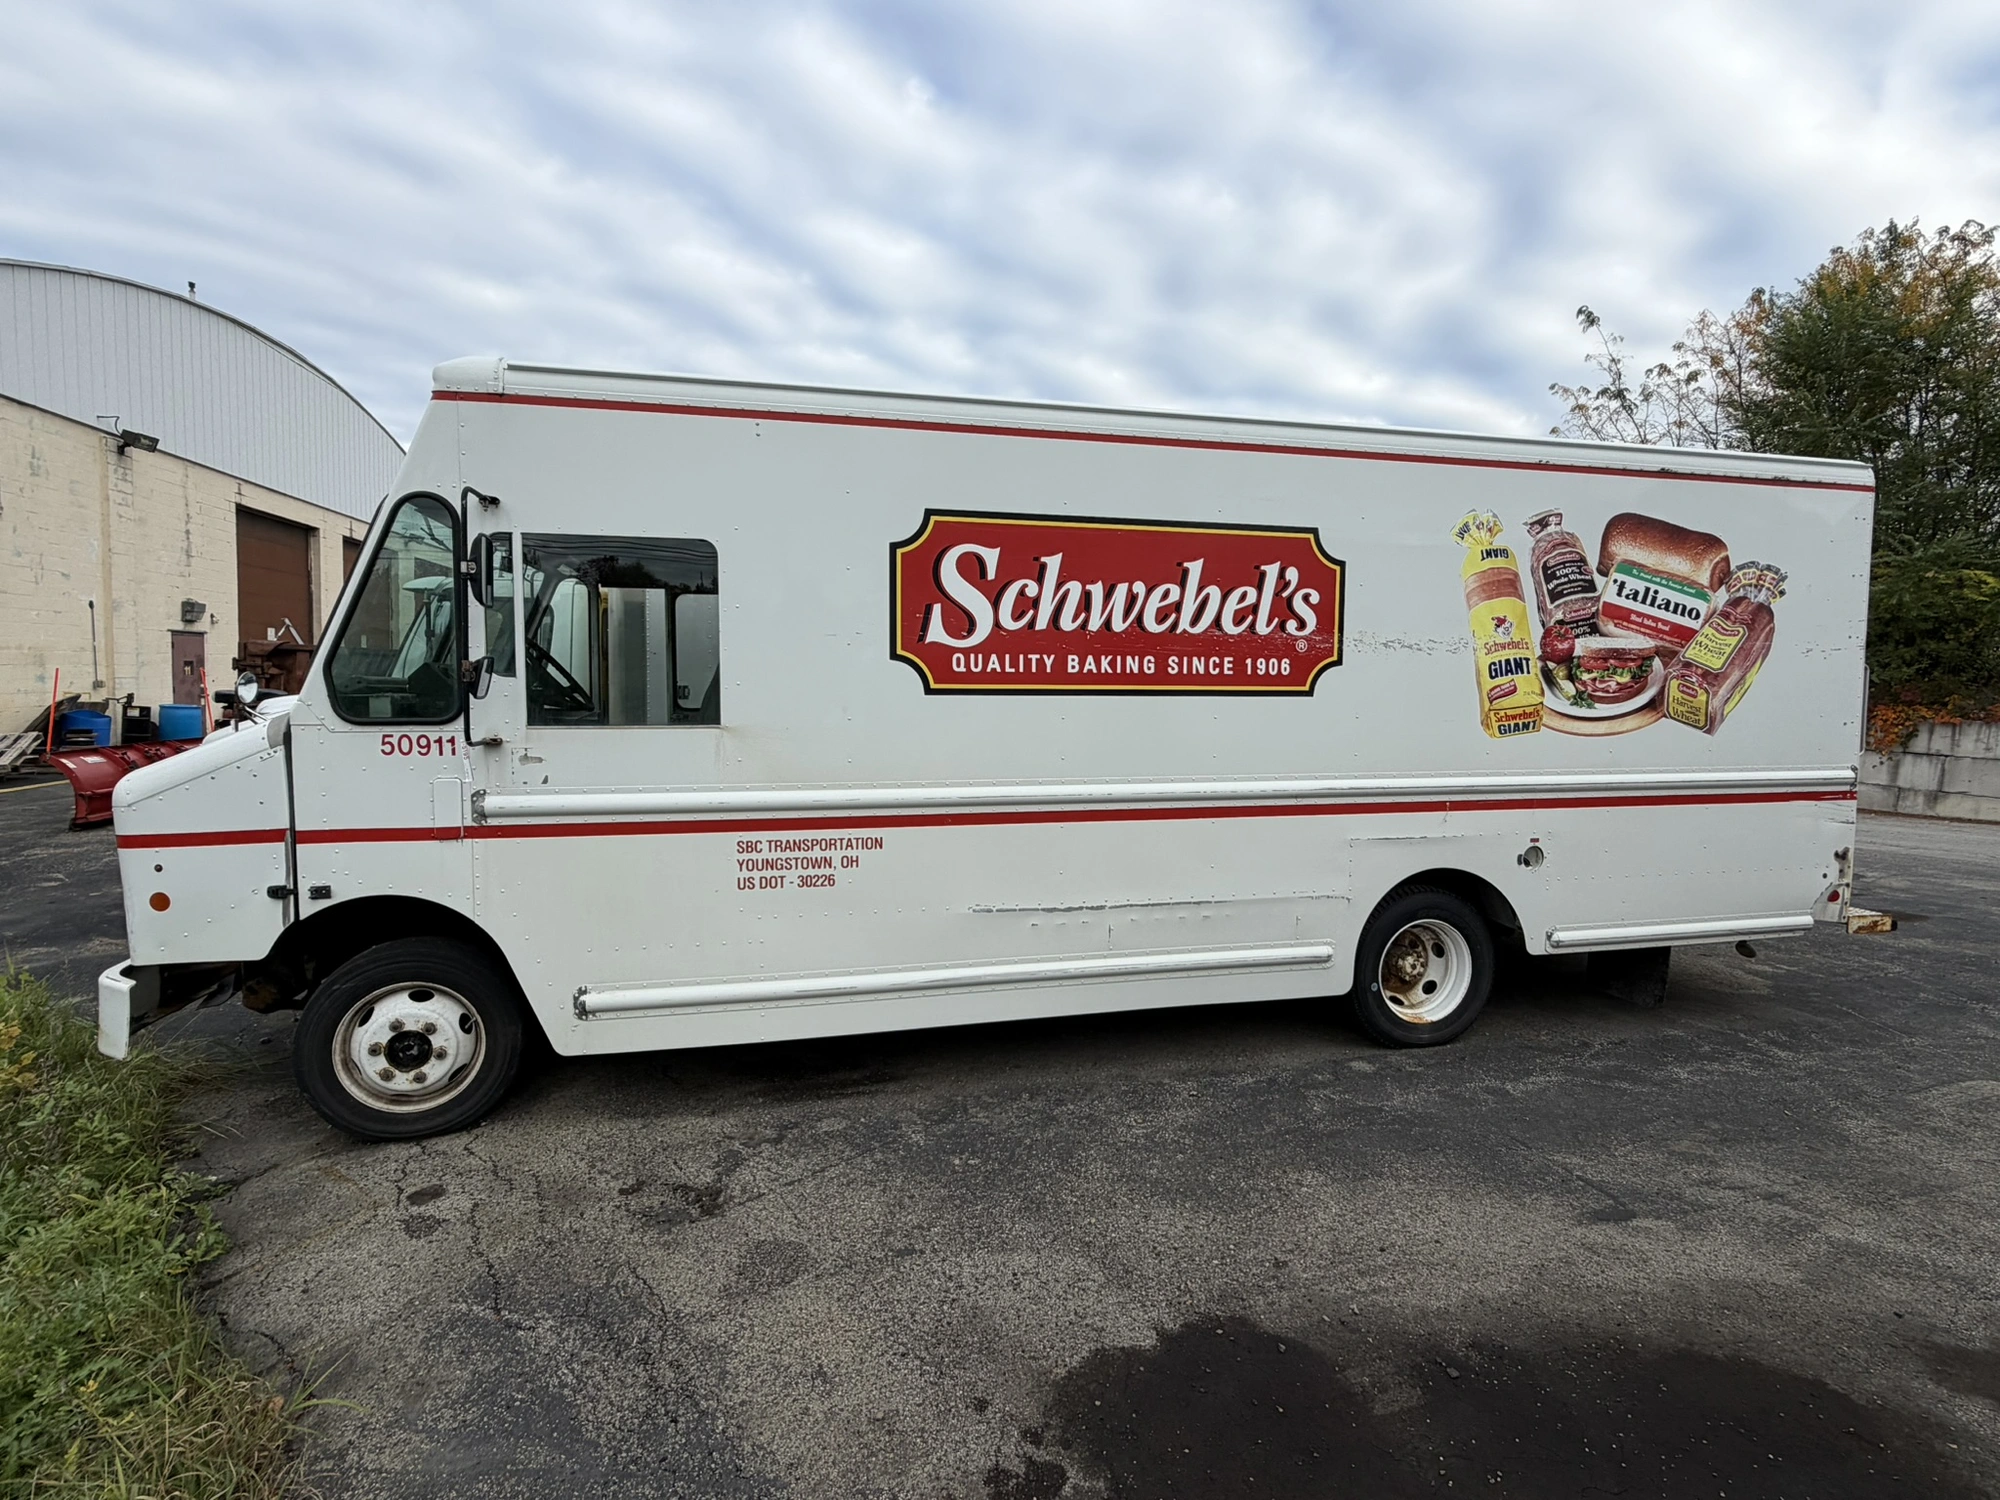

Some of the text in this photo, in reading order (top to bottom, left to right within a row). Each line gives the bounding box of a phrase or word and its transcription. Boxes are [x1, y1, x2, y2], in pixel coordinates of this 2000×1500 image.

[1480, 548, 1509, 562] GIANT
[1555, 567, 1580, 577] 100%
[920, 542, 1320, 648] Schwebel's
[1695, 640, 1726, 657] Wheat
[1700, 632, 1732, 648] Harvest
[951, 652, 1291, 676] QUALITY BAKING SINCE 1906
[1488, 657, 1531, 680] GIANT
[1672, 695, 1702, 713] Harvest
[1494, 706, 1540, 723] Schwebel's
[1673, 707, 1702, 725] Wheat
[1497, 719, 1538, 735] GIANT
[380, 733, 457, 757] 50911
[736, 837, 883, 854] SBC TRANSPORTATION
[737, 855, 859, 872] YOUNGSTOWN, OH
[737, 877, 756, 890] US
[759, 876, 786, 889] DOT
[797, 874, 836, 888] 30226
